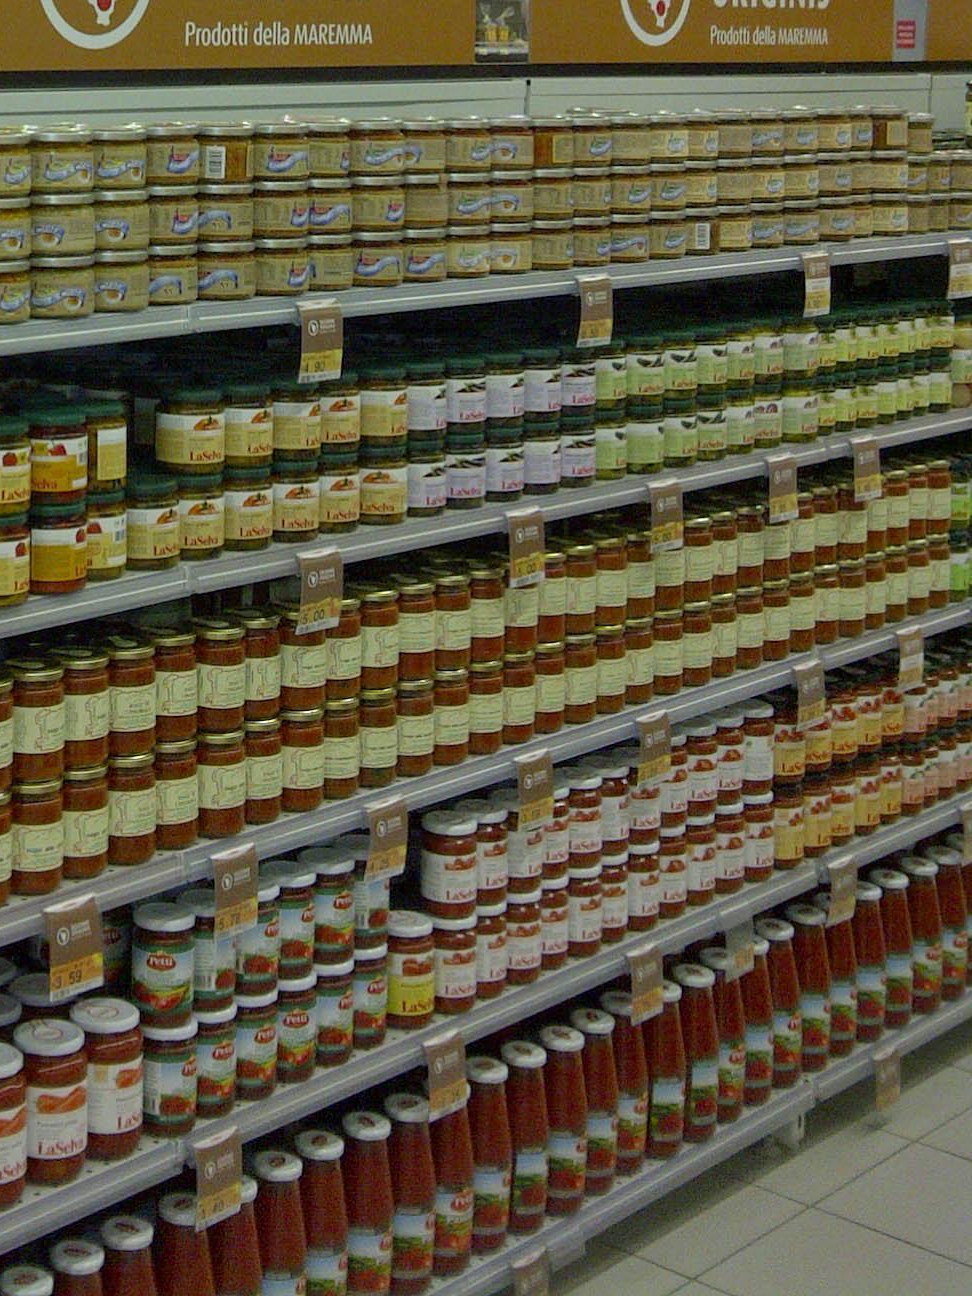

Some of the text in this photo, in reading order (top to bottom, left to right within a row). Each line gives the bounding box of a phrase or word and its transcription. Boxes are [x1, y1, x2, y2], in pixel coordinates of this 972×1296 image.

[184, 20, 373, 47] Prodotti della MAREMMA
[710, 24, 829, 47] Prodotti della MAREMMA
[31, 478, 58, 491] Selva
[147, 955, 174, 968] Petti
[286, 1014, 308, 1026] Petti
